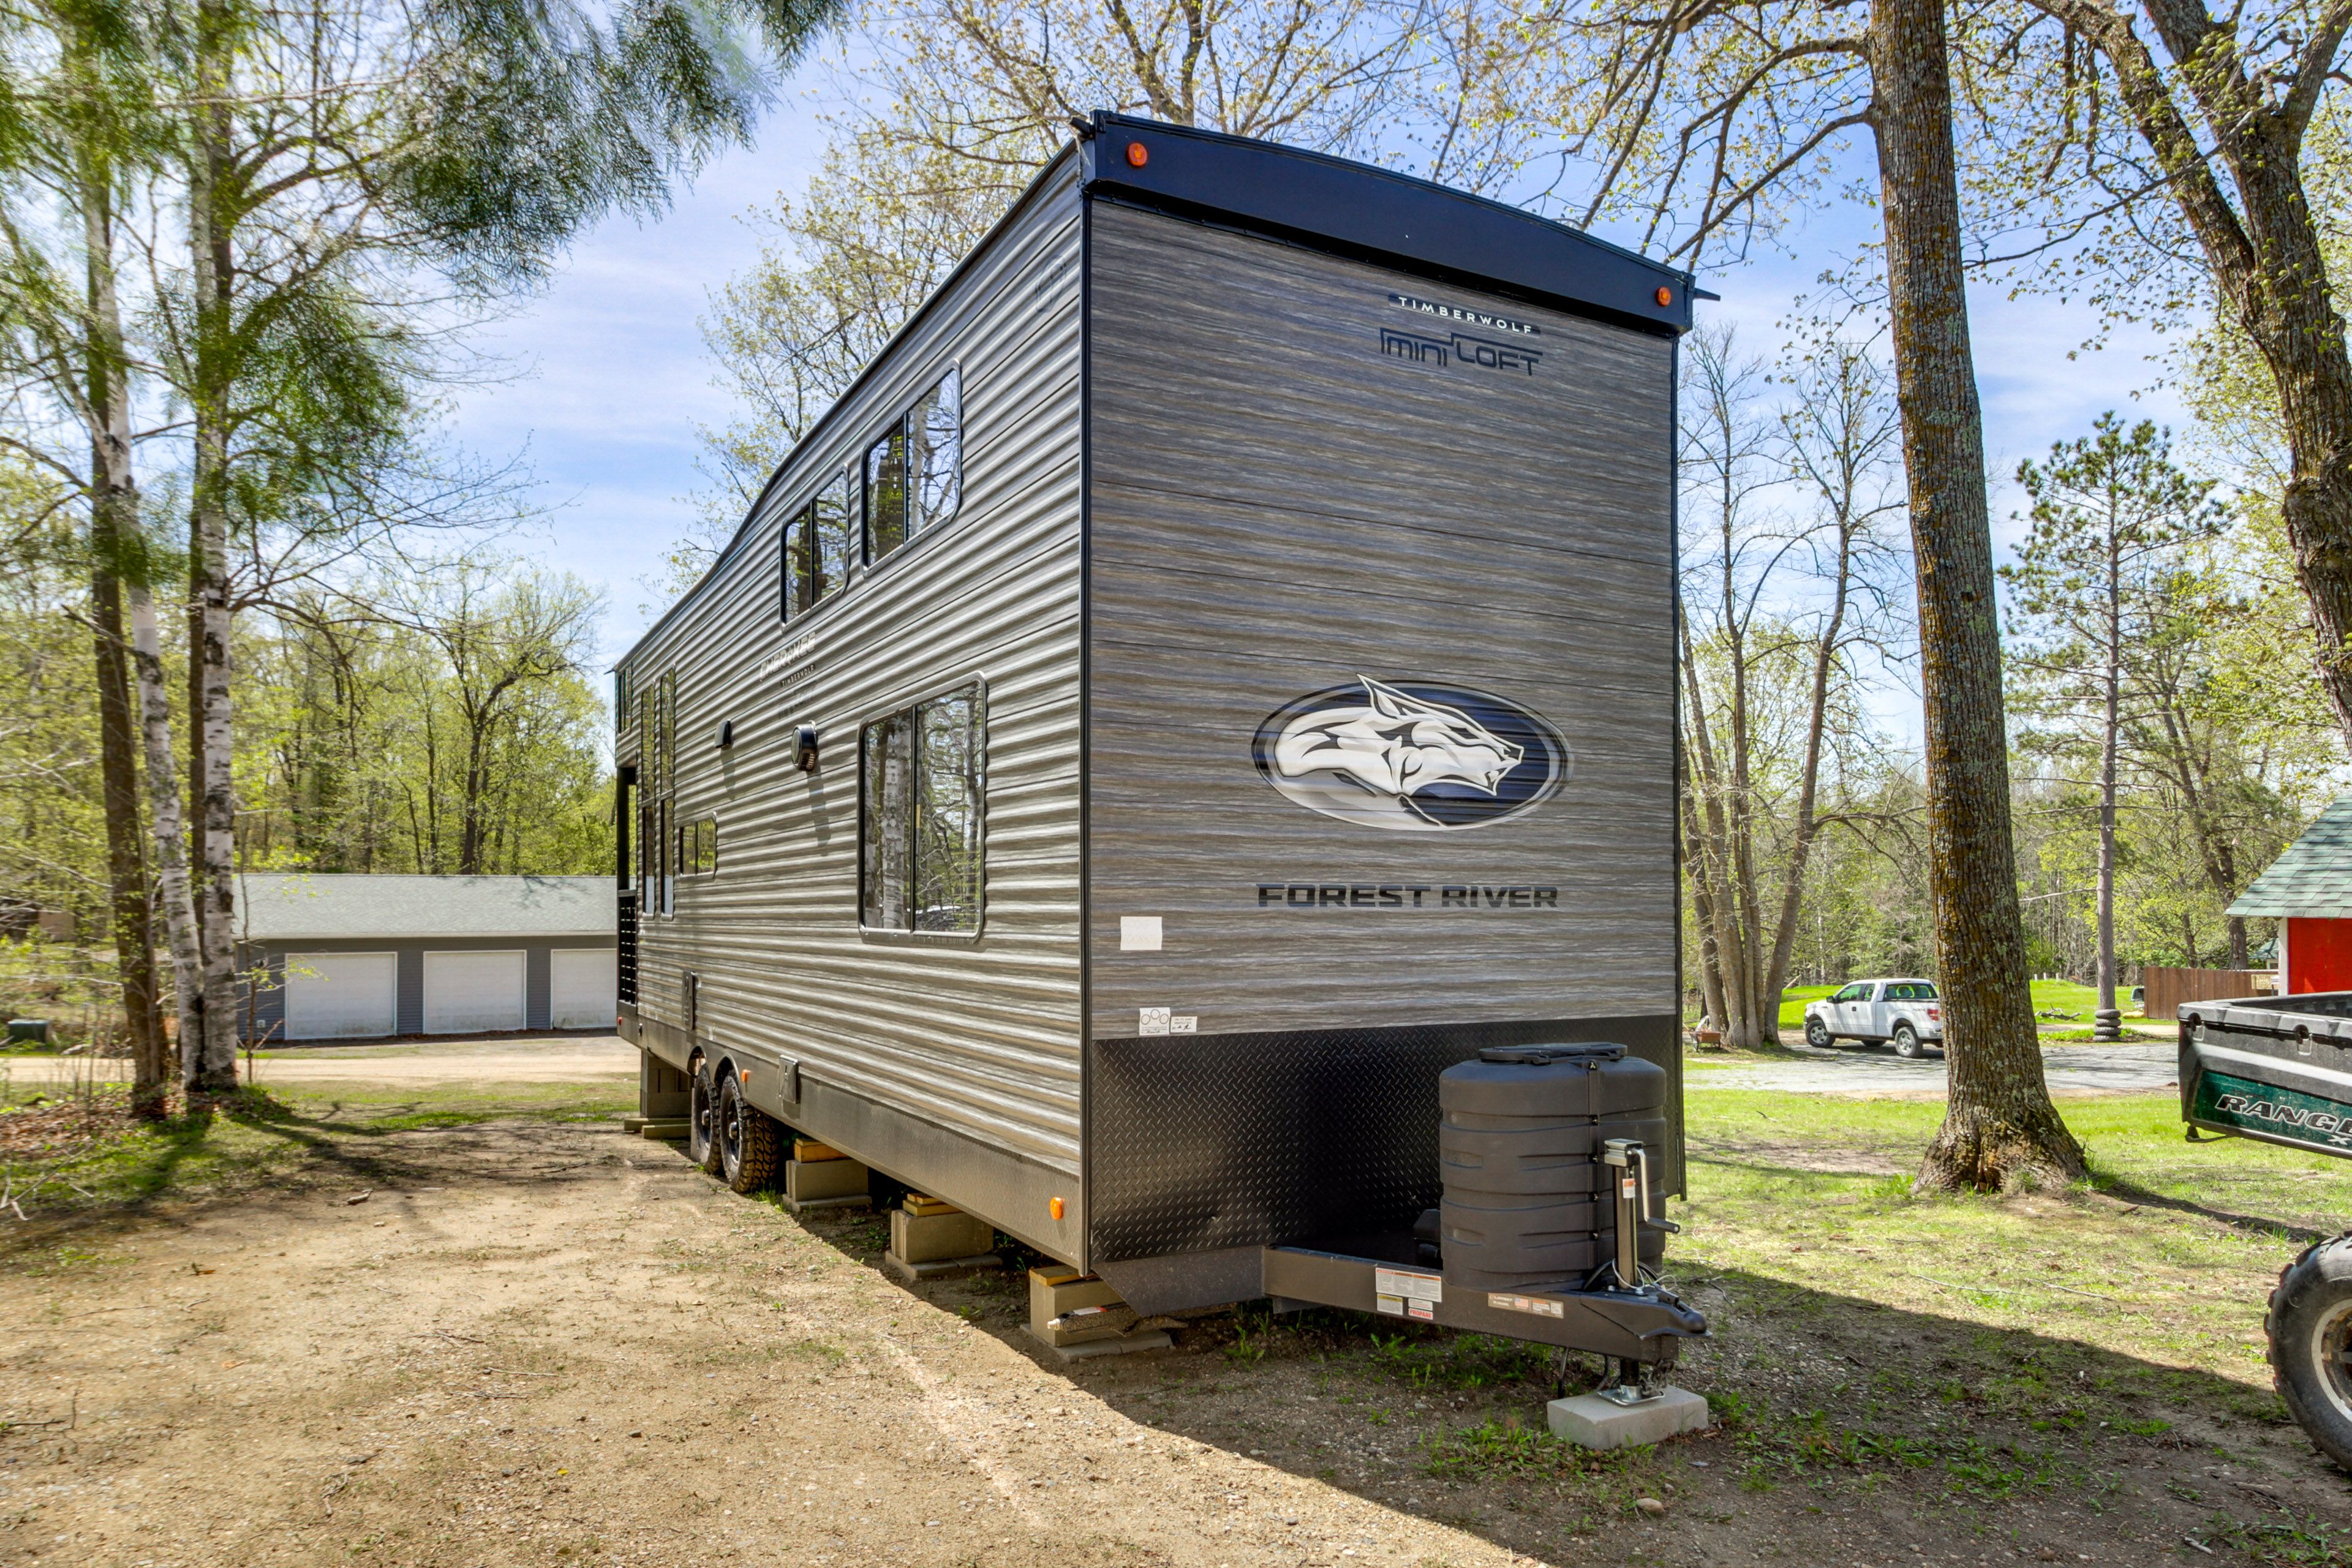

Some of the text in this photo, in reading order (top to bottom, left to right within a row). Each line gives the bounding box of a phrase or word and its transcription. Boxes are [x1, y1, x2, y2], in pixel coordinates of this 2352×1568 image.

[1398, 296, 1531, 334] TIMBERWOLF
[1457, 341, 1539, 376] LOFT
[782, 665, 815, 687] TIMBERWOLF
[1256, 883, 1558, 908] FOREST RIVER
[1409, 1308, 1431, 1319] PROPANE
